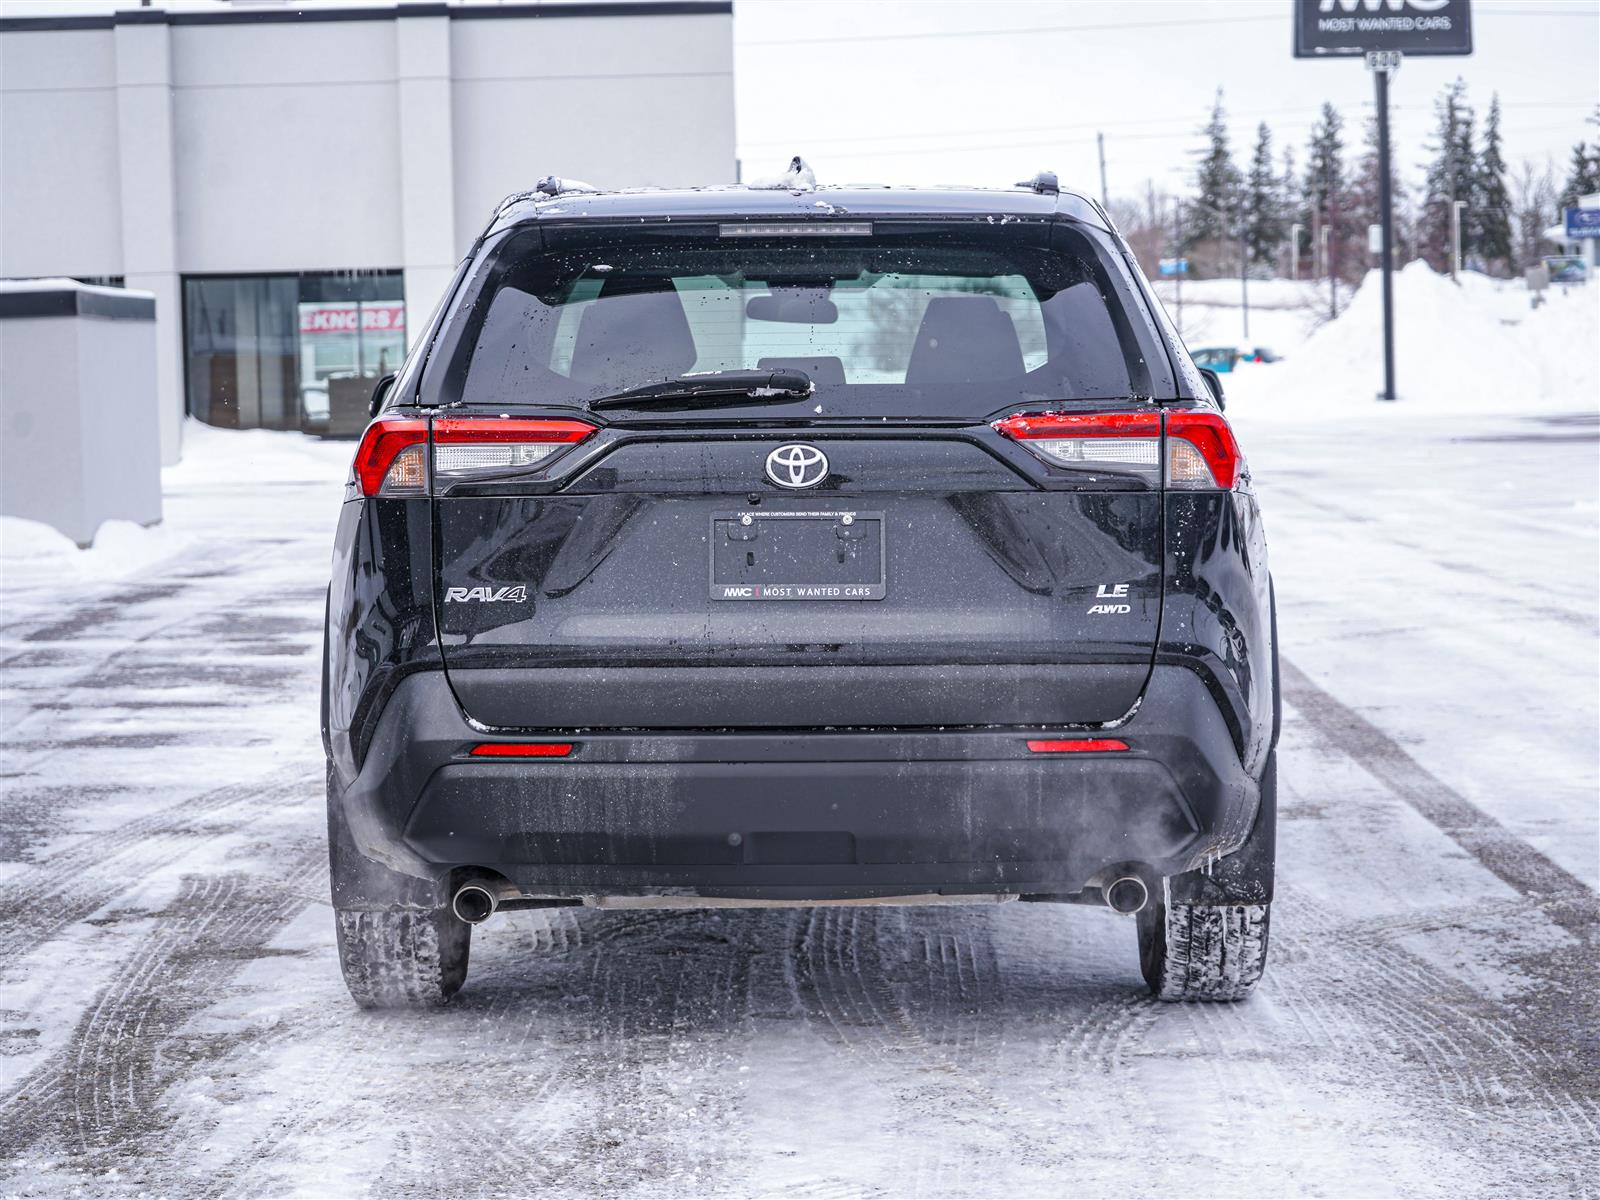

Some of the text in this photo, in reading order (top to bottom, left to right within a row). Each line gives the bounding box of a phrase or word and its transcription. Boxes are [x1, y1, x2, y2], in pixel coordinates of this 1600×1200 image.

[1318, 16, 1452, 31] MOST WANTED CARS
[444, 586, 527, 603] RAV4
[763, 588, 792, 596] MOST
[797, 587, 840, 596] WANTED
[845, 587, 871, 596] CARS
[1096, 584, 1130, 598] LE
[1087, 604, 1131, 614] AWD
